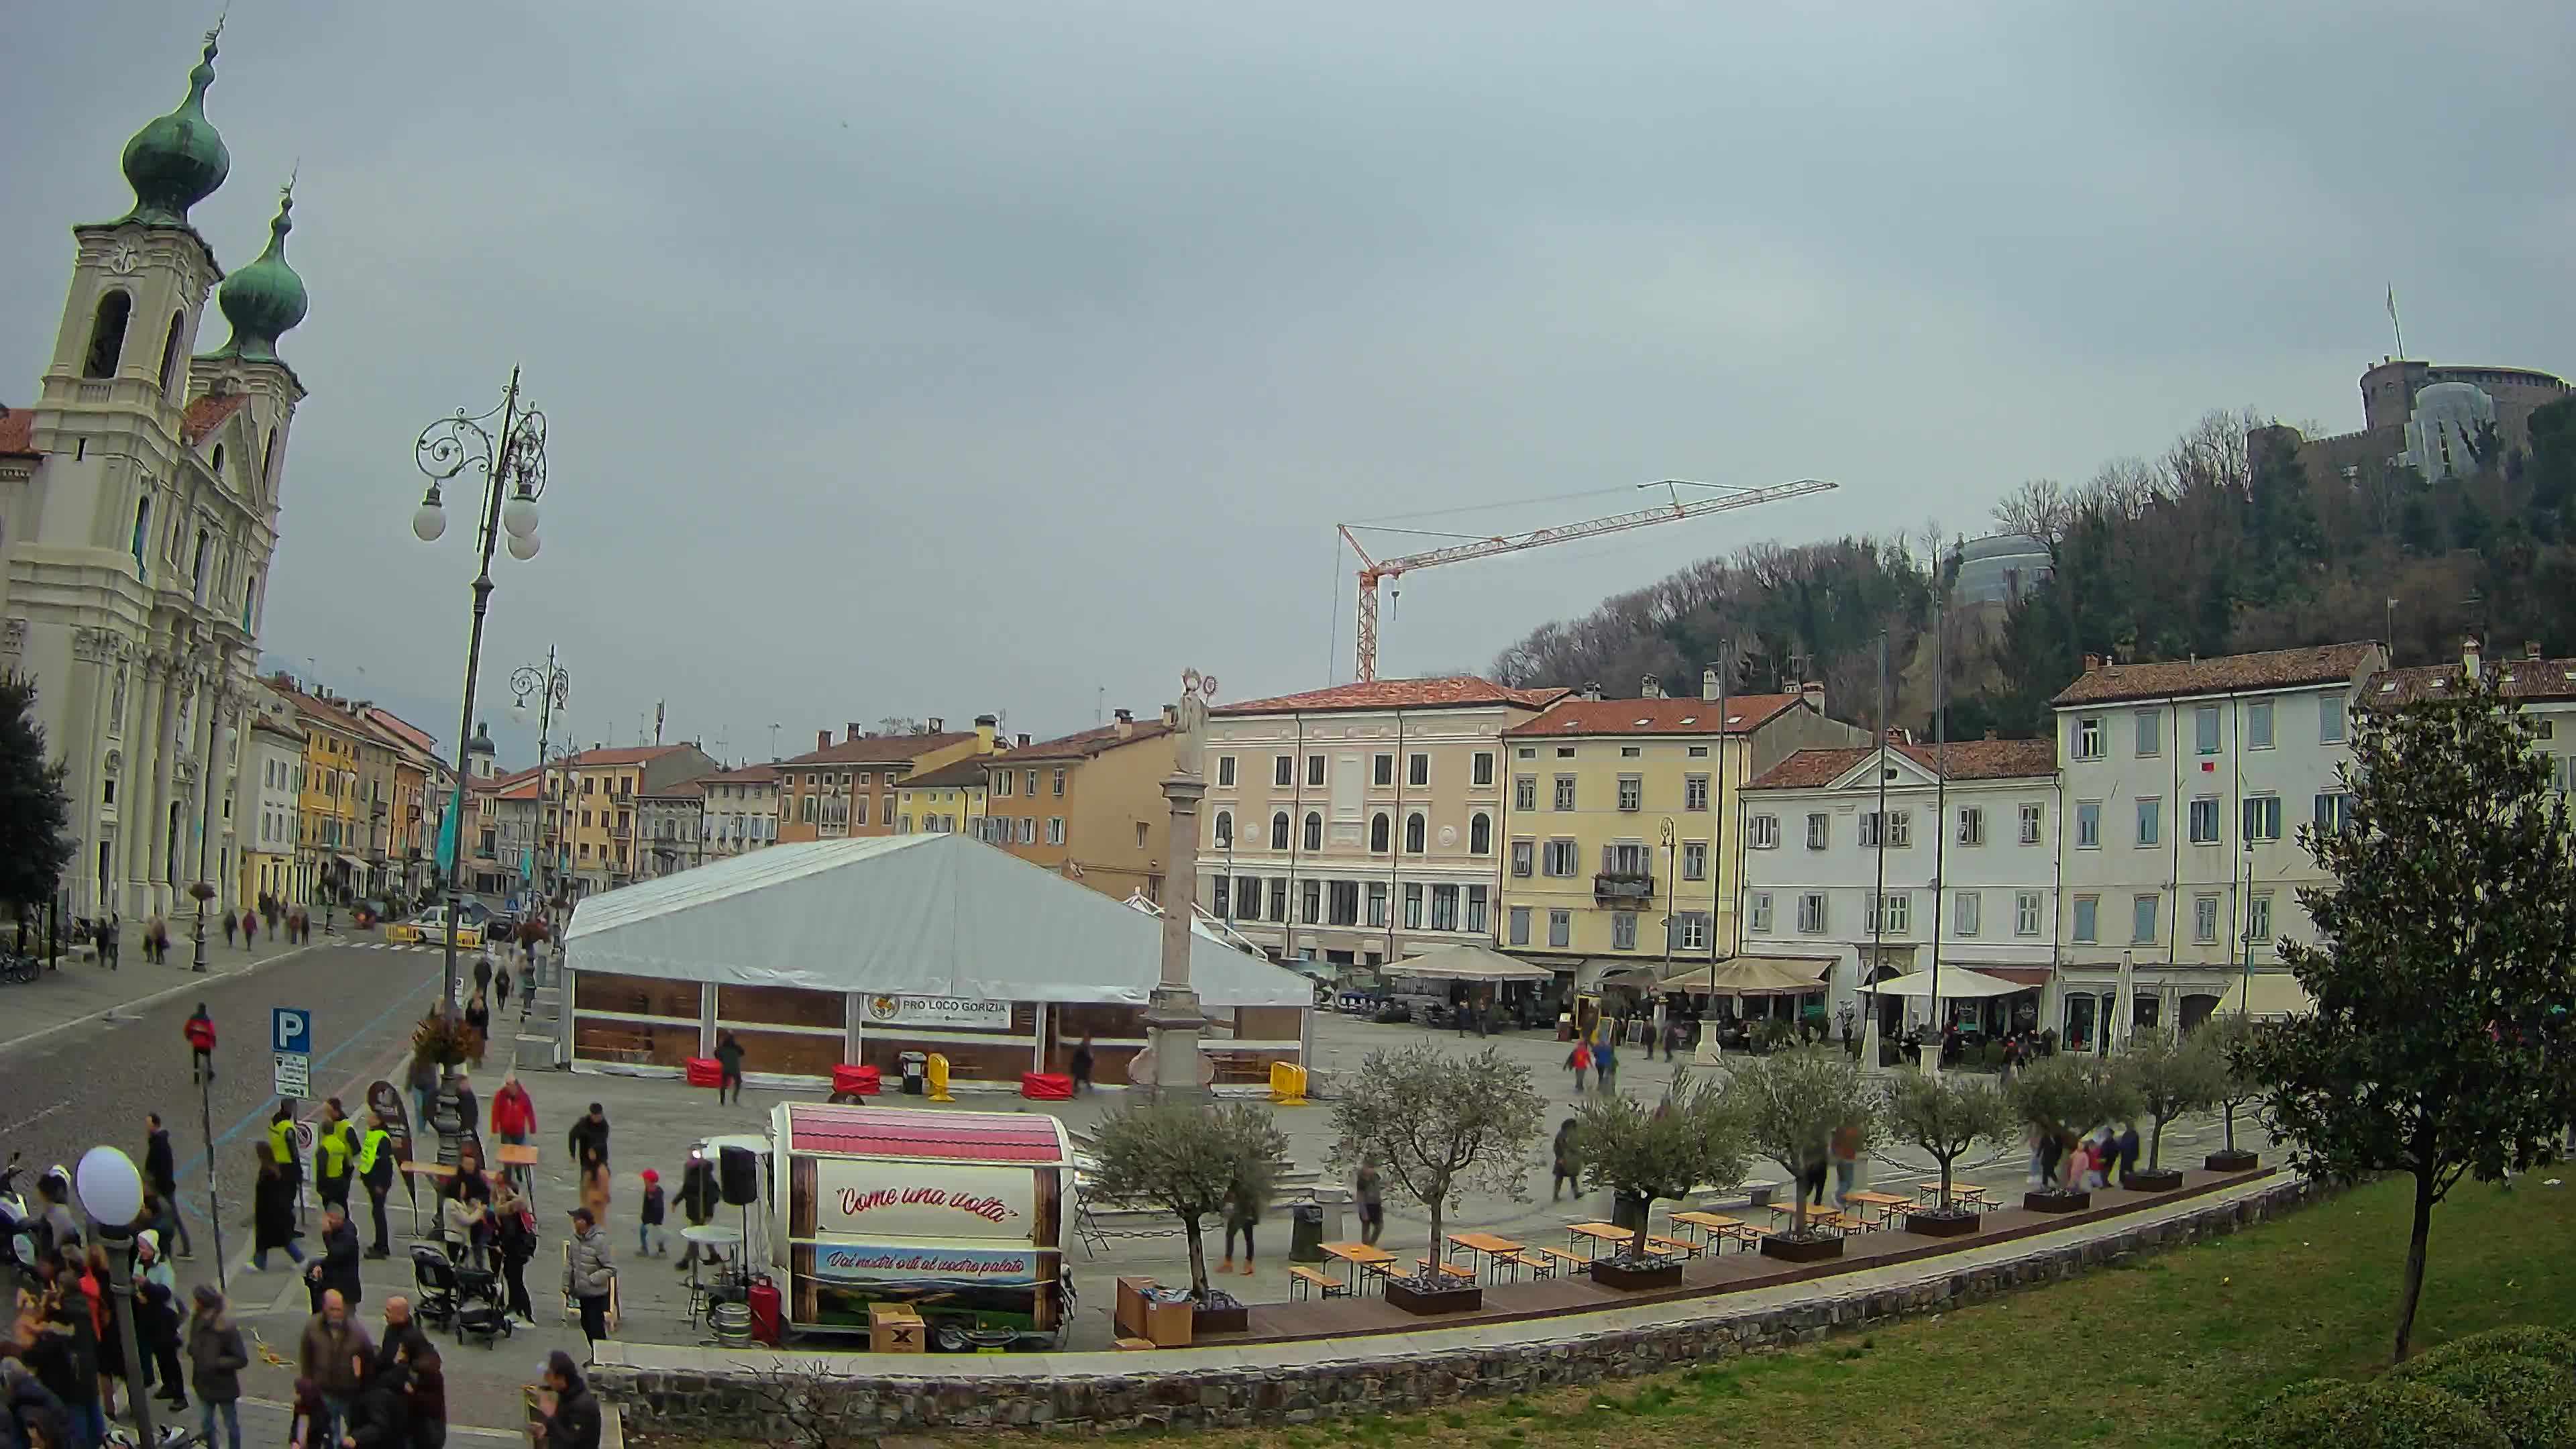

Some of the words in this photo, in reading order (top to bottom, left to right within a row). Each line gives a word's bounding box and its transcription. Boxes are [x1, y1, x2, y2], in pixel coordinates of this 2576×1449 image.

[903, 1000, 926, 1010] PRO
[928, 1000, 959, 1011] LOCO
[961, 1002, 1006, 1012] GORIZIA
[279, 1011, 304, 1047] P
[901, 1187, 947, 1205] una
[826, 1250, 858, 1267] Dai
[920, 1255, 938, 1271] al
[977, 1257, 1024, 1277] palato
